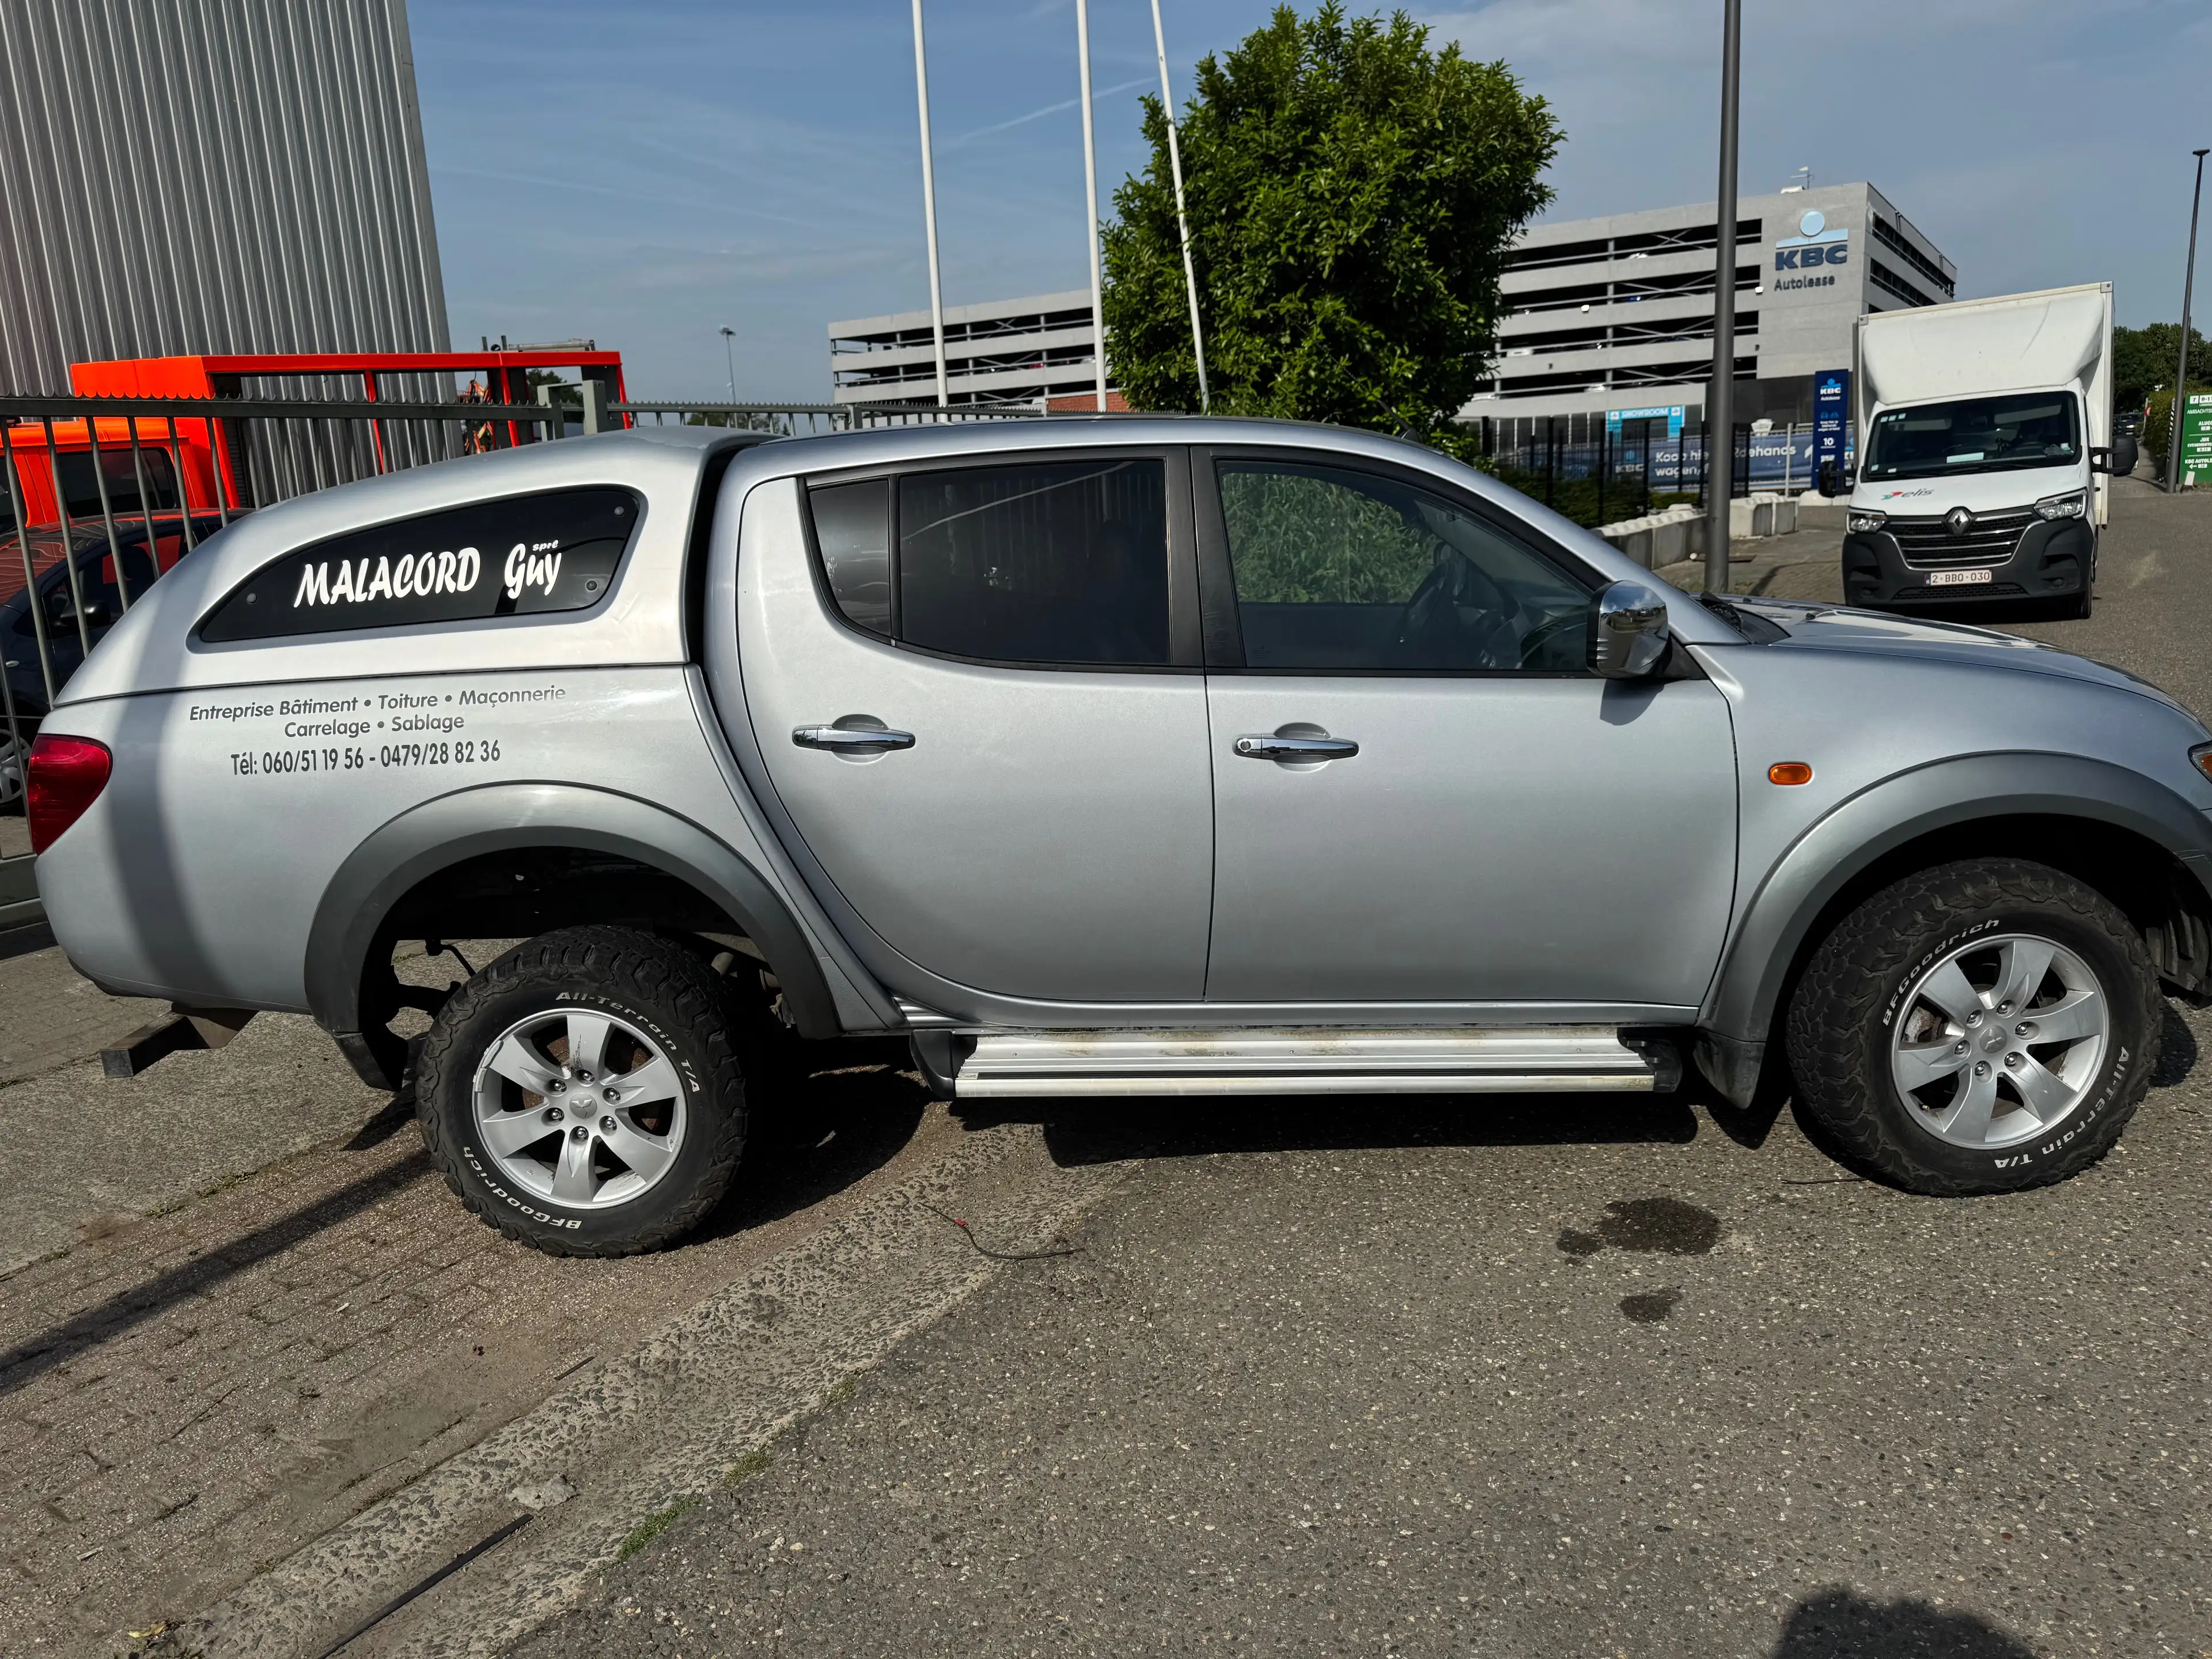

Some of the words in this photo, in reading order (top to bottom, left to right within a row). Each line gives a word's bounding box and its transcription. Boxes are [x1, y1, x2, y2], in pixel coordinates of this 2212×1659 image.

[1775, 244, 1847, 271] KBC
[1774, 275, 1835, 291] Autolease
[1622, 407, 1668, 418] SHOWROOM
[1823, 437, 1834, 446] 10
[1902, 488, 1934, 497] elis
[294, 547, 481, 608] MALACORD
[504, 543, 562, 599] Guy
[190, 702, 274, 722] Entreprise
[280, 697, 358, 715] Bâtiment
[378, 693, 438, 709] Toiture
[459, 685, 566, 707] Maçonnerie
[285, 719, 370, 738] Carrelage
[392, 714, 464, 733] Sablage
[230, 752, 257, 775] Tél:
[263, 749, 317, 774] 060/51
[323, 748, 338, 770] 19
[344, 747, 363, 769] 56
[381, 743, 449, 767] 0479/28
[454, 741, 474, 763] 82
[480, 740, 500, 762] 36
[1883, 919, 1999, 1025] BFGoodrich
[555, 992, 677, 1050] All-Terrain
[681, 1059, 700, 1092] T/A
[2041, 1047, 2129, 1154] All-Terrain
[1994, 1154, 2033, 1168] T/A
[463, 1147, 582, 1229] BFGoodrich
